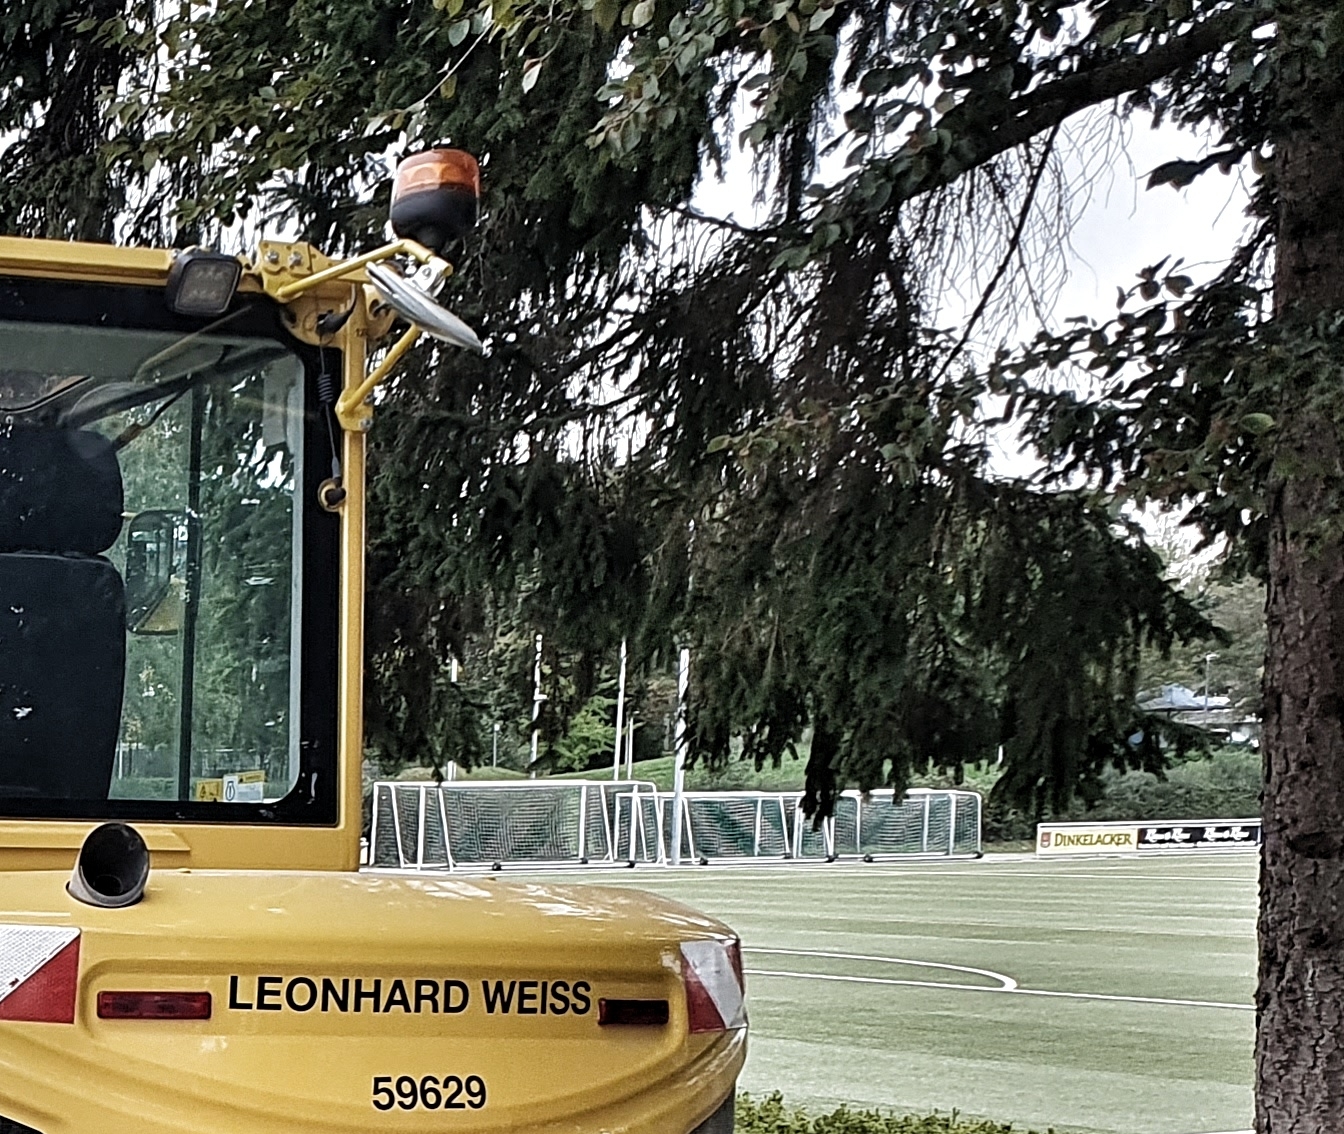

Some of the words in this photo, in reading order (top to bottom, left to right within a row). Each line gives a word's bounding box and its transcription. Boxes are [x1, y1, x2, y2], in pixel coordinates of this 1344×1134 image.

[1054, 832, 1132, 848] DINKELACKER
[228, 975, 470, 1014] LEONHARD
[481, 979, 592, 1015] WEISS
[372, 1074, 487, 1111] 59629
